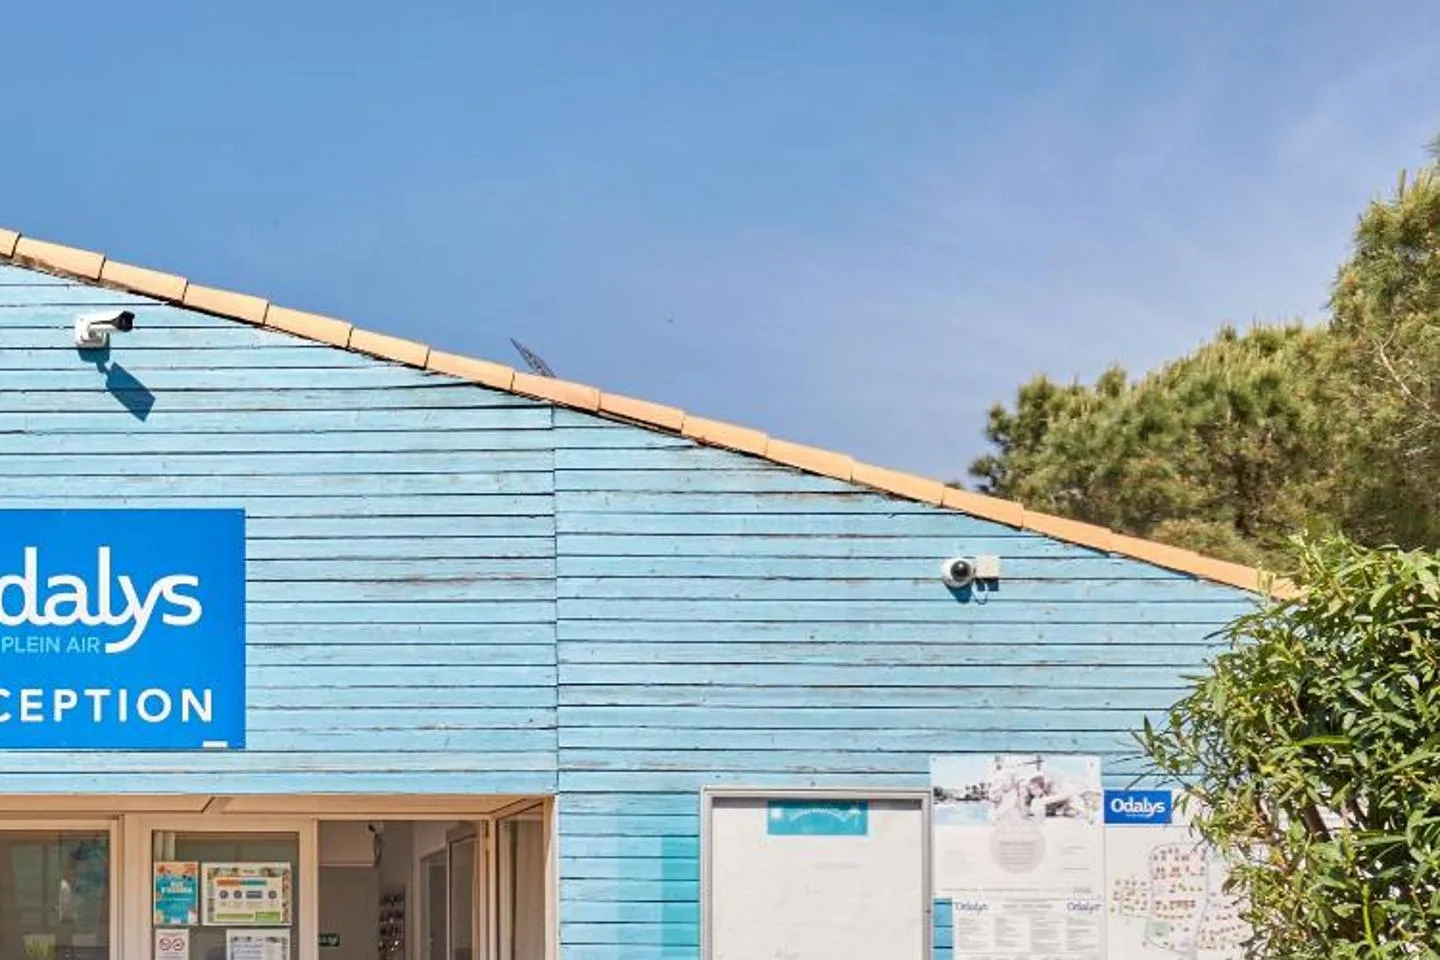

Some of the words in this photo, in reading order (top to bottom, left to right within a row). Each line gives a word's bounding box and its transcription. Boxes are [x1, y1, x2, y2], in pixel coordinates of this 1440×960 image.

[1, 637, 61, 654] PLEIN
[66, 637, 101, 654] AIR
[1110, 796, 1166, 817] Odalys
